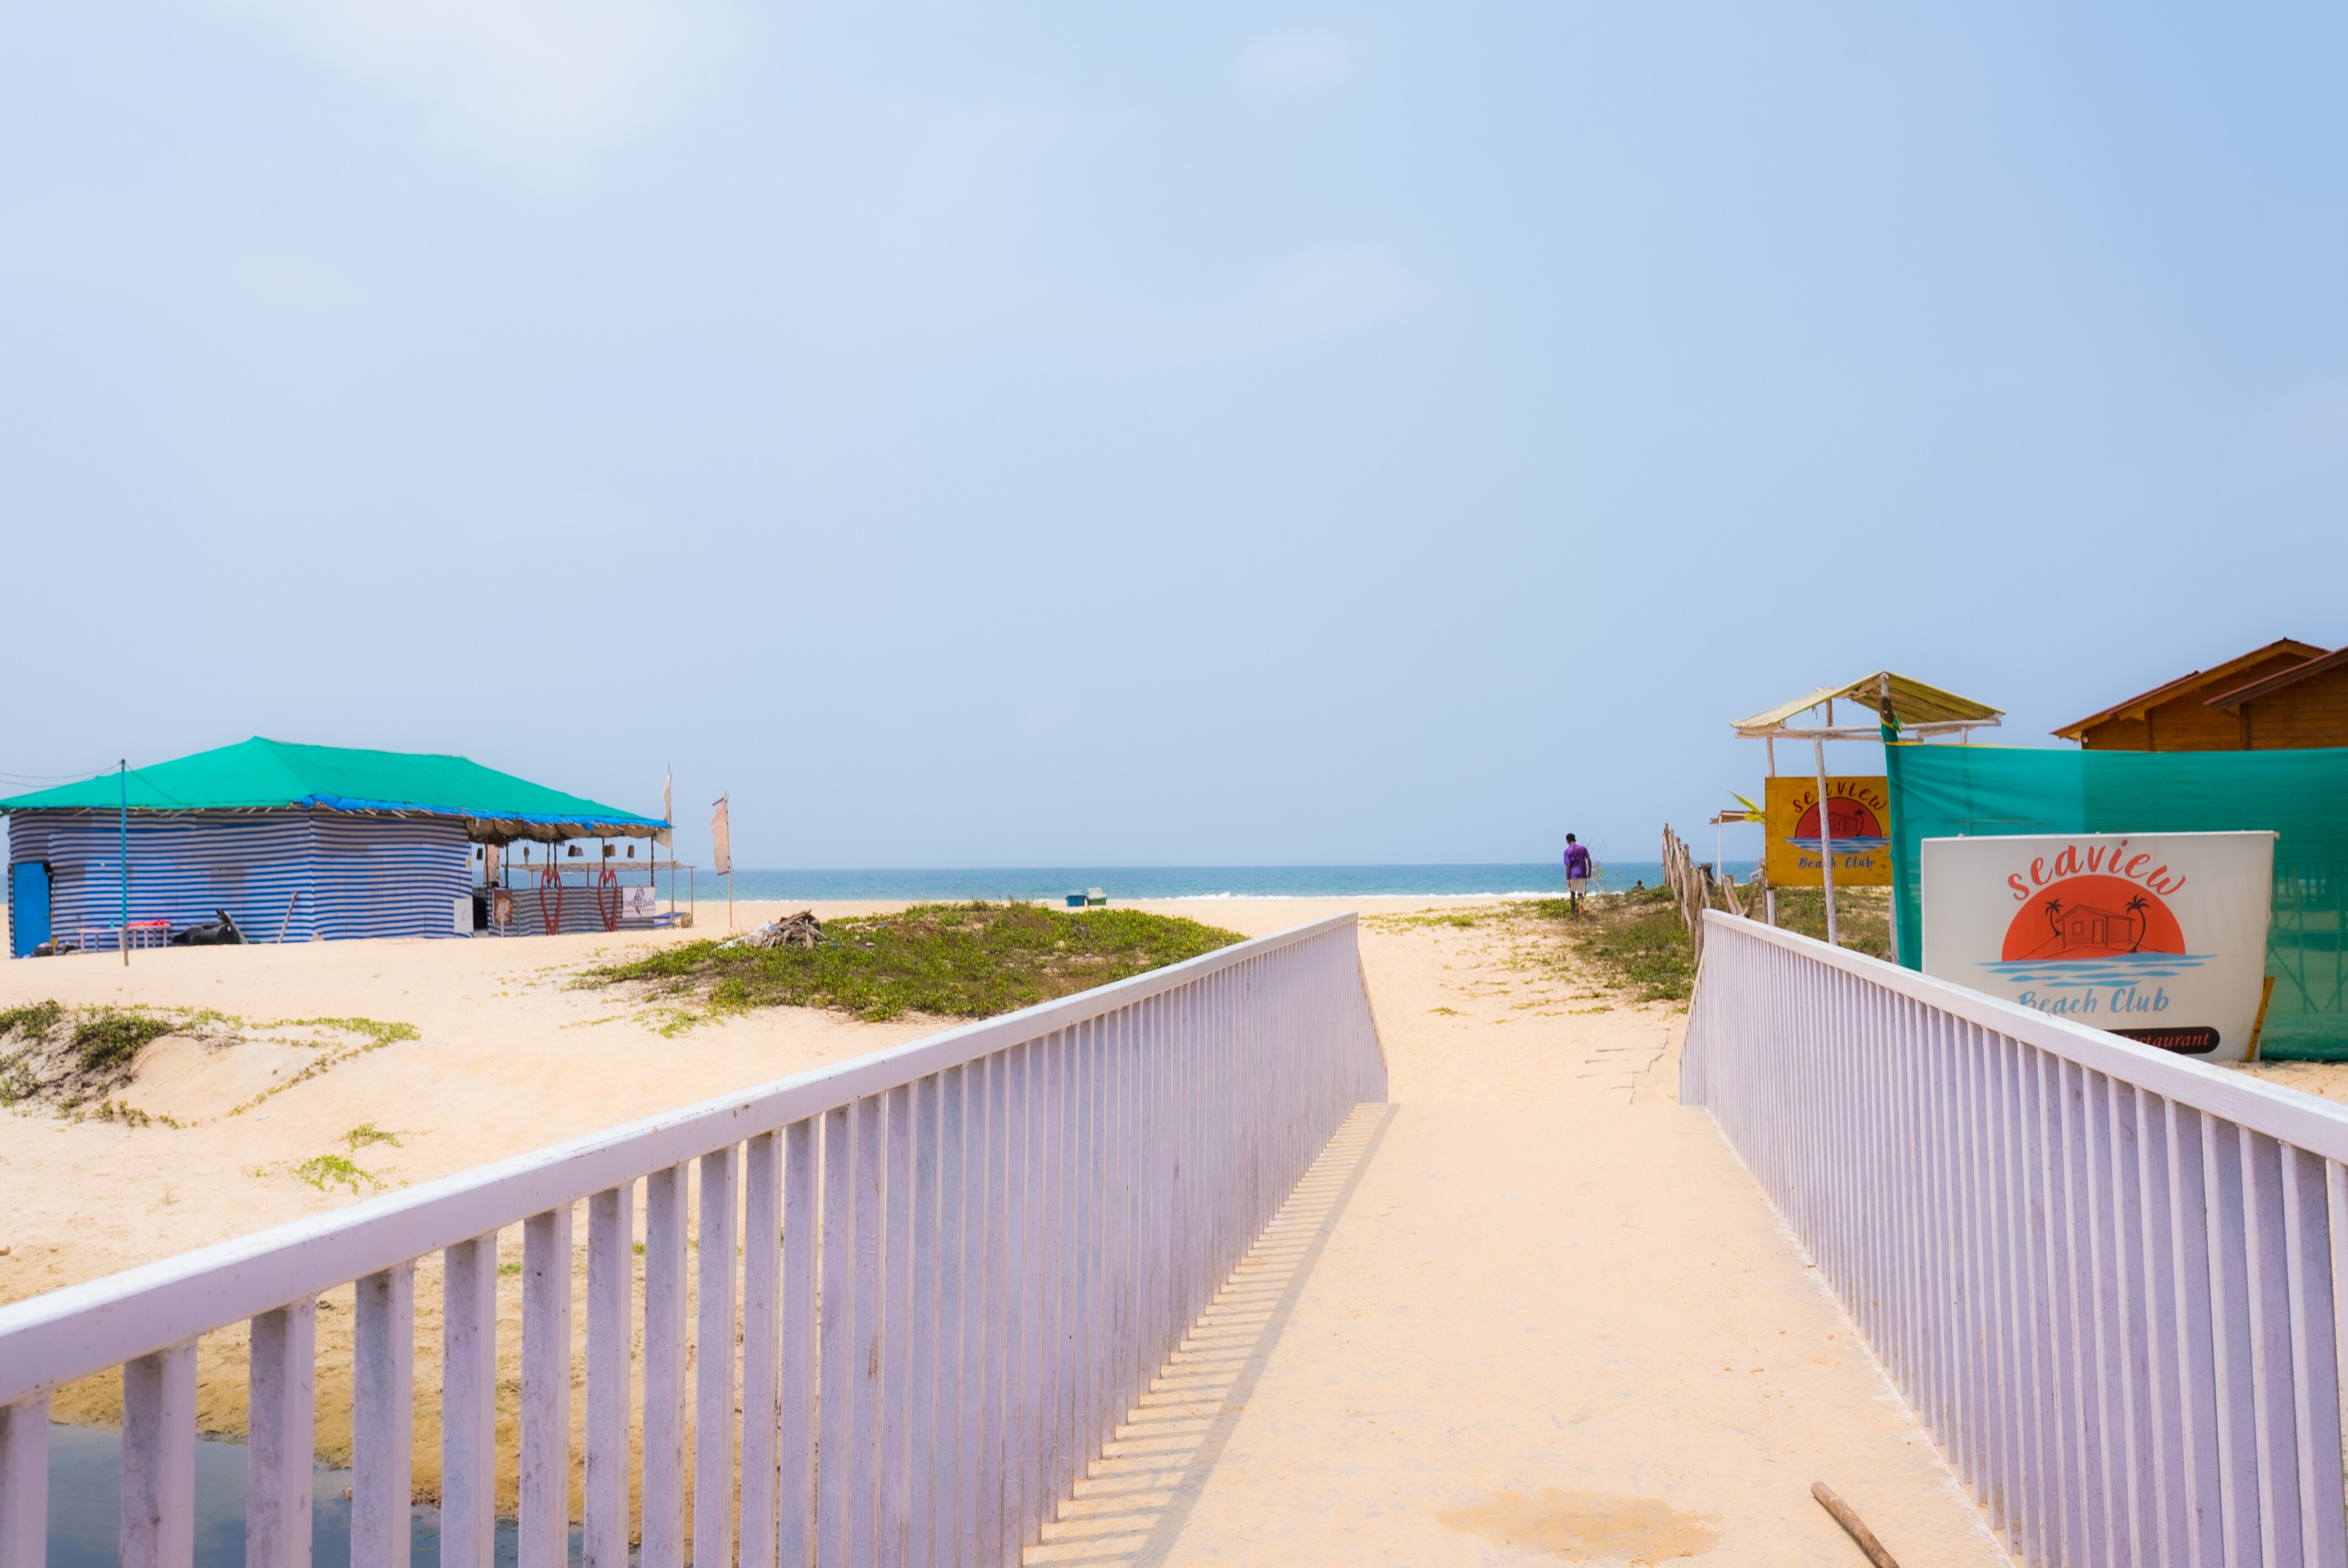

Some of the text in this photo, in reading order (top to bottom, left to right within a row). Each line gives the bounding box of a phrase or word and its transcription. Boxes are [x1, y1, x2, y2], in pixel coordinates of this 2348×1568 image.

[1799, 856, 1873, 869] Beah Club
[2017, 987, 2170, 1014] Beach Club
